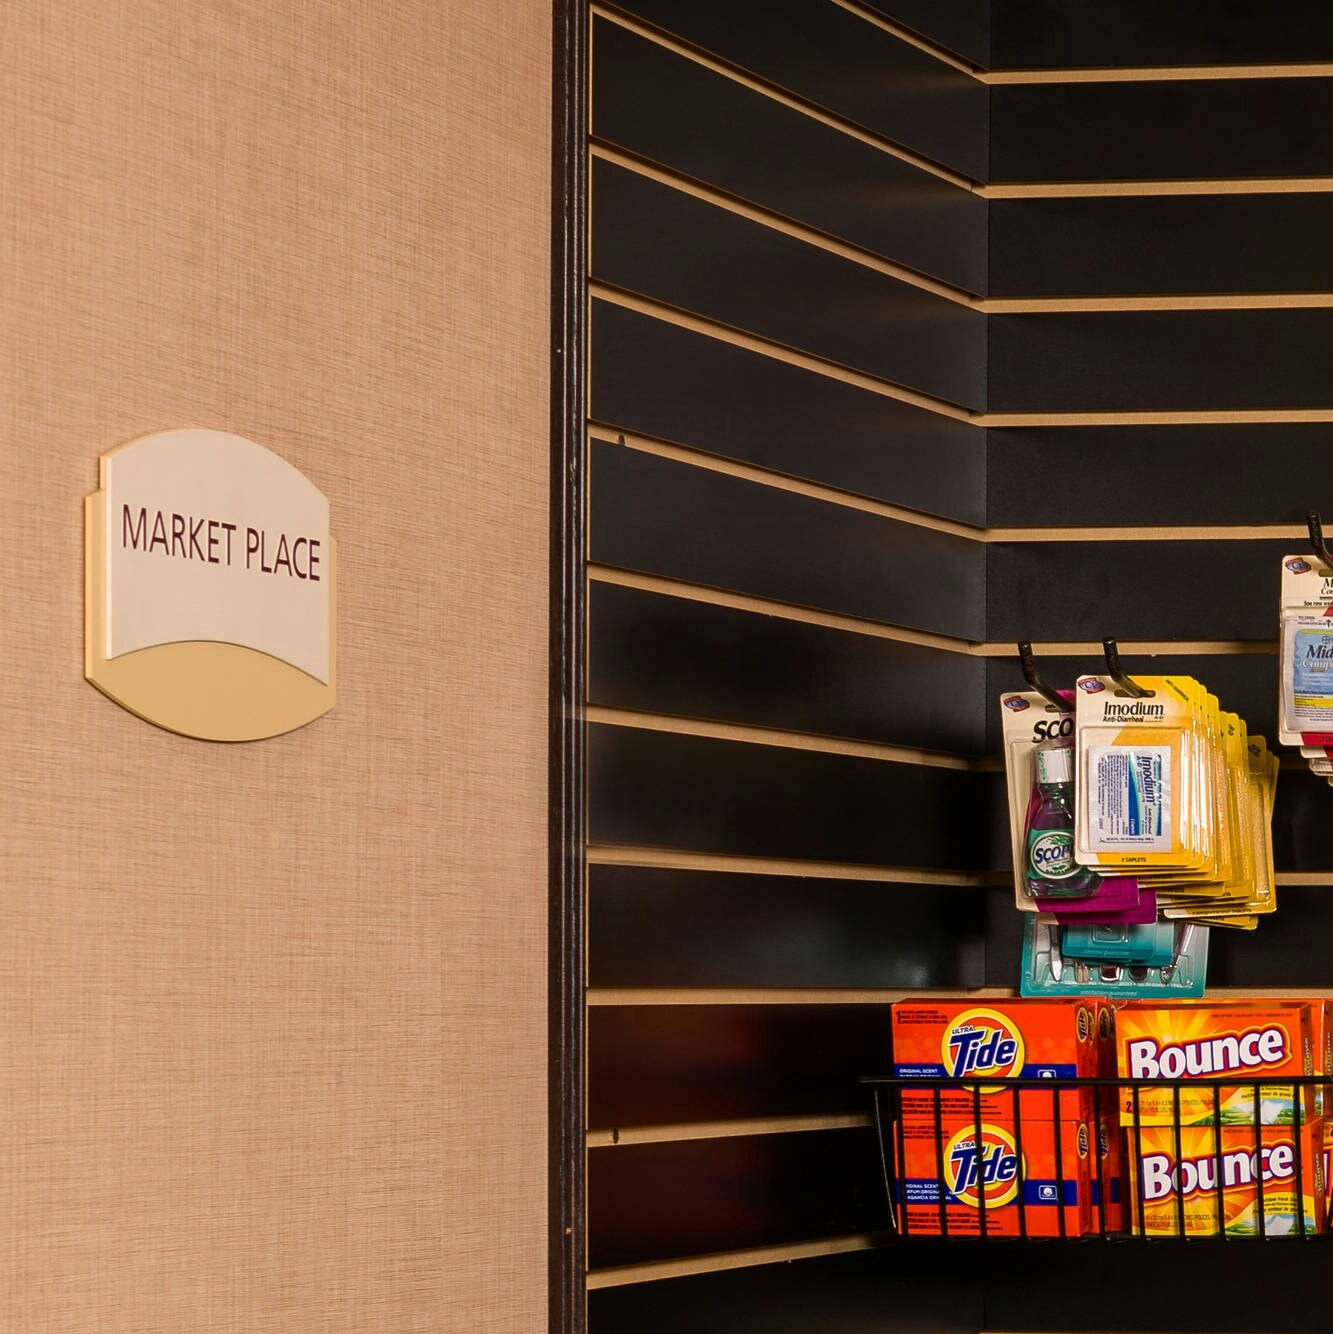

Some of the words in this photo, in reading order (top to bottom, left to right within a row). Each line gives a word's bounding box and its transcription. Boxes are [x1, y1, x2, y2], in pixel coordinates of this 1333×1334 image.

[122, 504, 236, 566] MARKET
[246, 528, 320, 581] PLACE
[1104, 702, 1164, 716] Imodium
[950, 1030, 1017, 1077] Tide
[1130, 1028, 1283, 1079] Bounce
[951, 1147, 1018, 1194] Tide
[1142, 1145, 1294, 1199] Bounce
